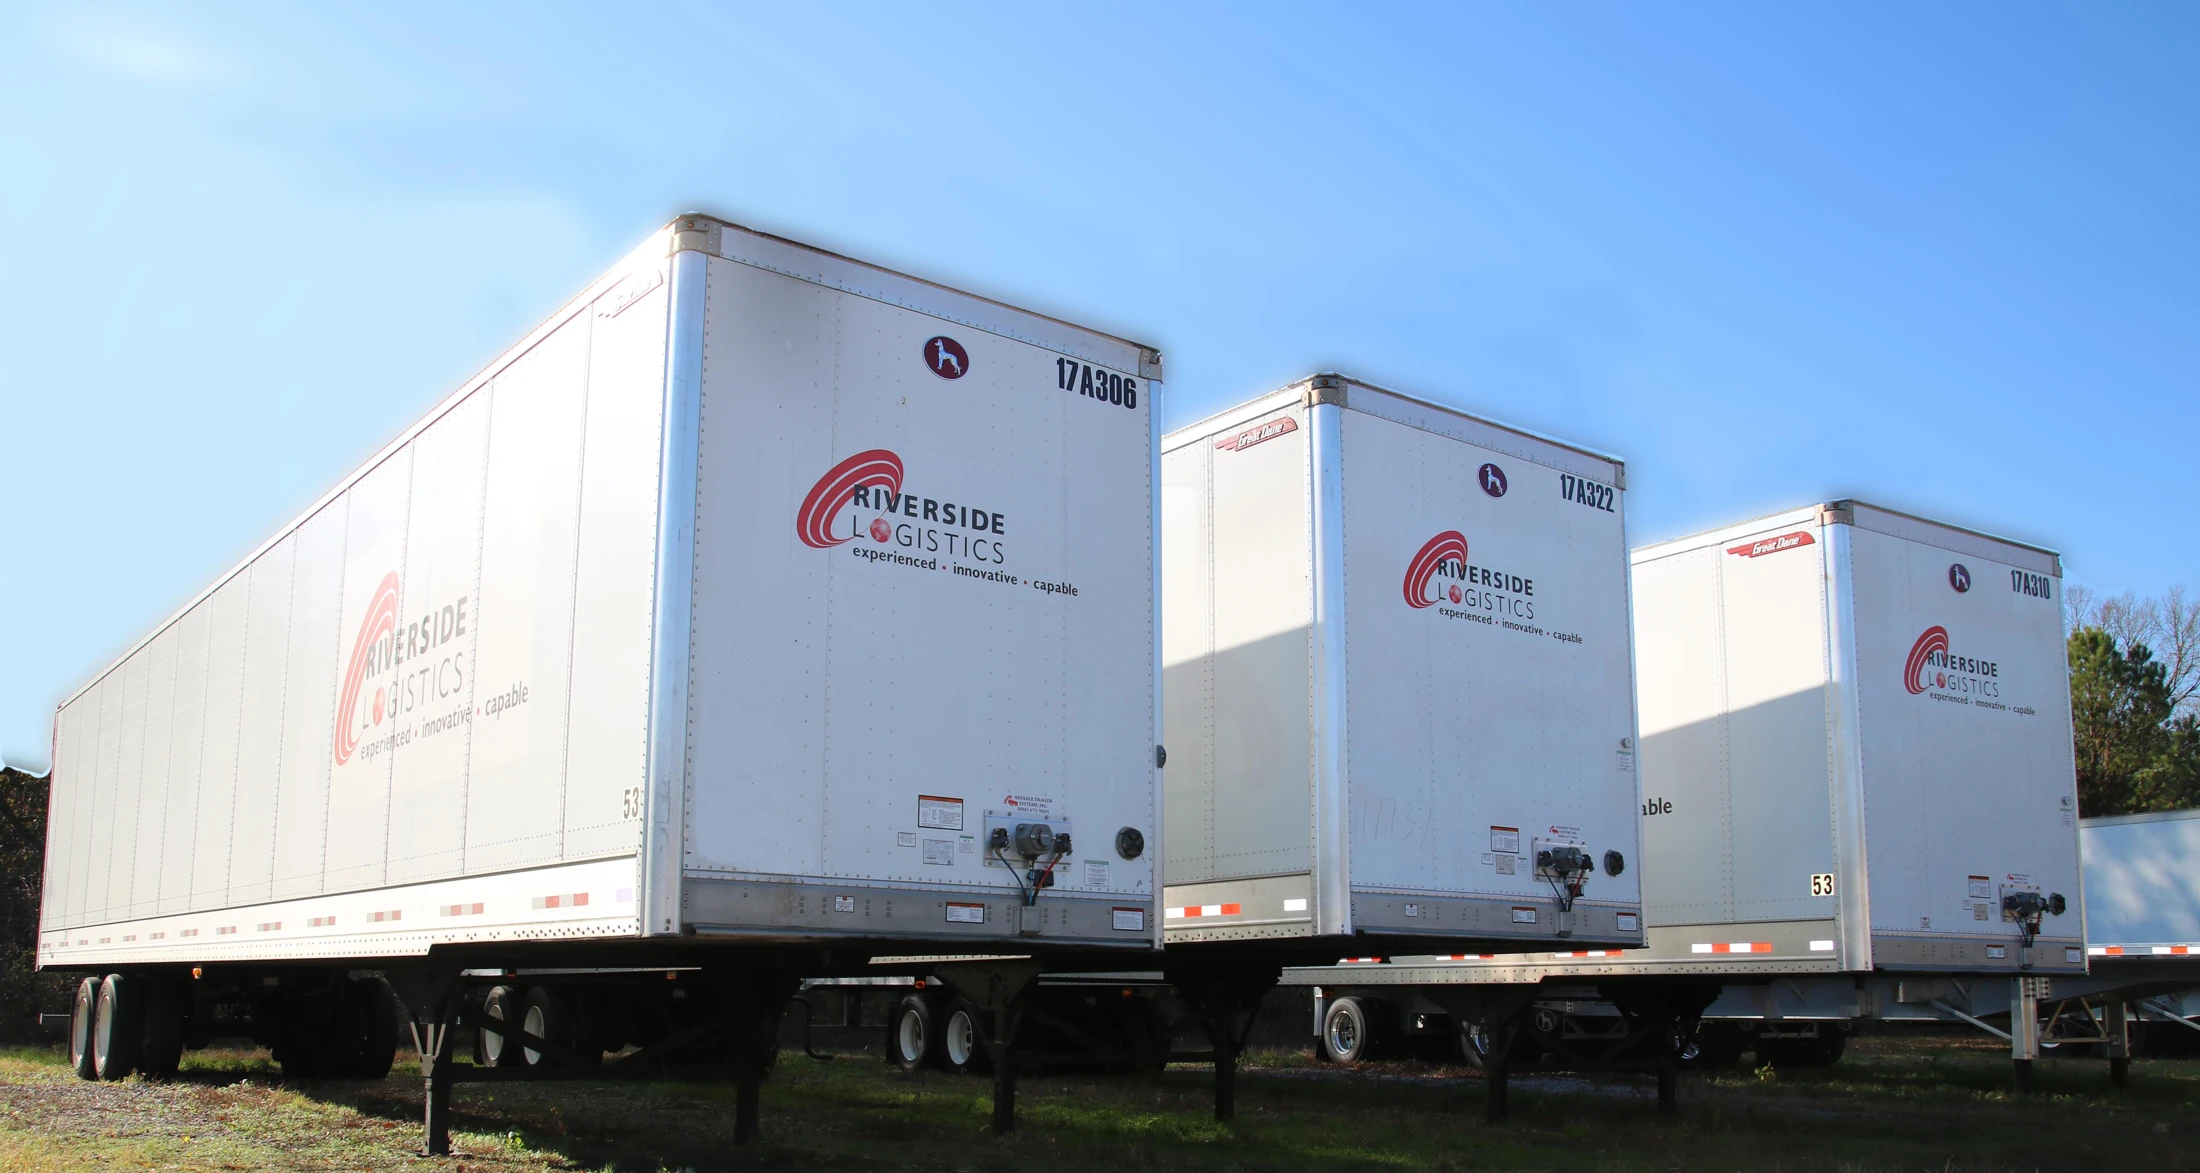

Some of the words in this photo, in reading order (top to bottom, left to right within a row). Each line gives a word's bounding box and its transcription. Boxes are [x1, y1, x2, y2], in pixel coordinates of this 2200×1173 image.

[1056, 357, 1137, 410] 17A306
[1238, 431, 1263, 448] Great
[1260, 424, 1284, 440] Dane
[853, 484, 1005, 535] RIVERSIDE
[1560, 473, 1615, 513] 17A322
[853, 514, 1005, 564] LOGISTICS
[1752, 541, 1778, 555] Great
[1776, 536, 1800, 550] Dane
[852, 546, 937, 571] experienced
[953, 562, 1018, 585] innovative
[1033, 578, 1079, 597] capable
[1437, 558, 1534, 596] RIVERSIDE
[2010, 569, 2051, 600] 17A310
[1438, 582, 1534, 620] LOGISTICS
[366, 595, 468, 680] RIVERSIDE
[1439, 607, 1492, 625] experienced
[1502, 617, 1544, 636] innovative
[1553, 630, 1583, 644] capable
[1927, 651, 1998, 678] RIVERSIDE
[1928, 671, 1999, 698] LOGISTICS
[361, 722, 412, 763] experienced
[421, 704, 472, 739] innovative
[485, 680, 529, 720] capable
[1929, 692, 1969, 705] experienced
[1975, 698, 2007, 711] innovative
[2012, 705, 2036, 716] capable
[623, 786, 640, 820] 53
[1813, 874, 1833, 895] 53
